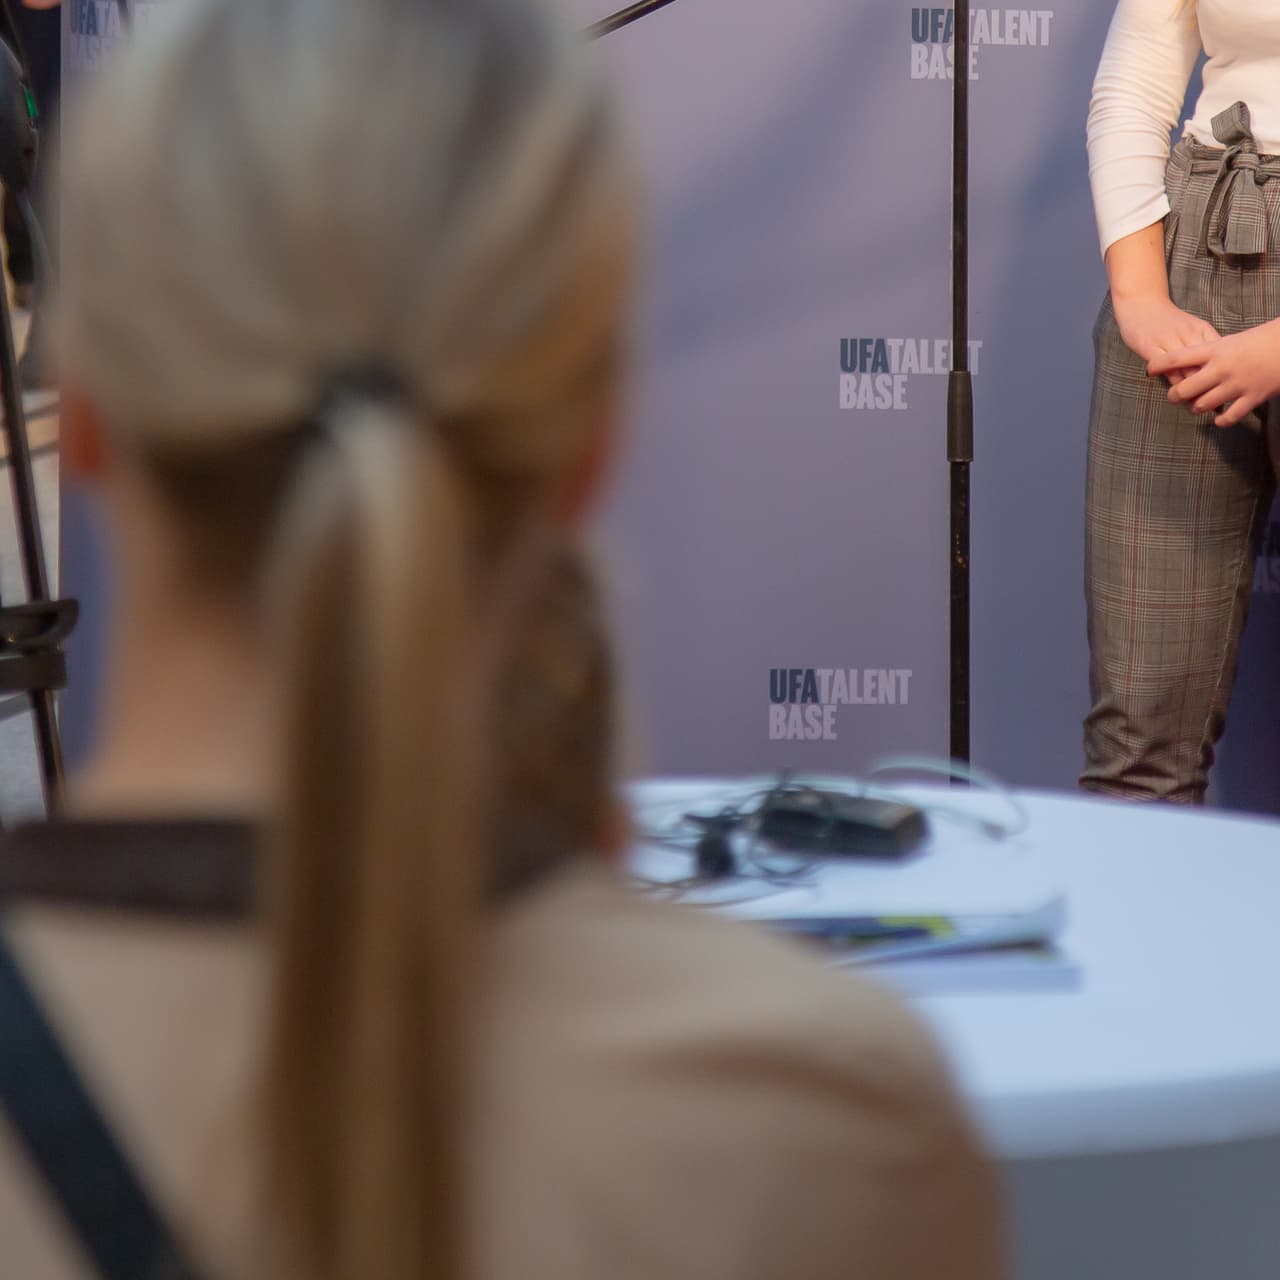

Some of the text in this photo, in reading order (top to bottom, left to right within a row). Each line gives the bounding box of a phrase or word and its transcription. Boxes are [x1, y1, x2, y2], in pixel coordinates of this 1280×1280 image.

[839, 337, 983, 376] UFATALET
[838, 374, 908, 410] BASE
[768, 704, 838, 741] BASE
